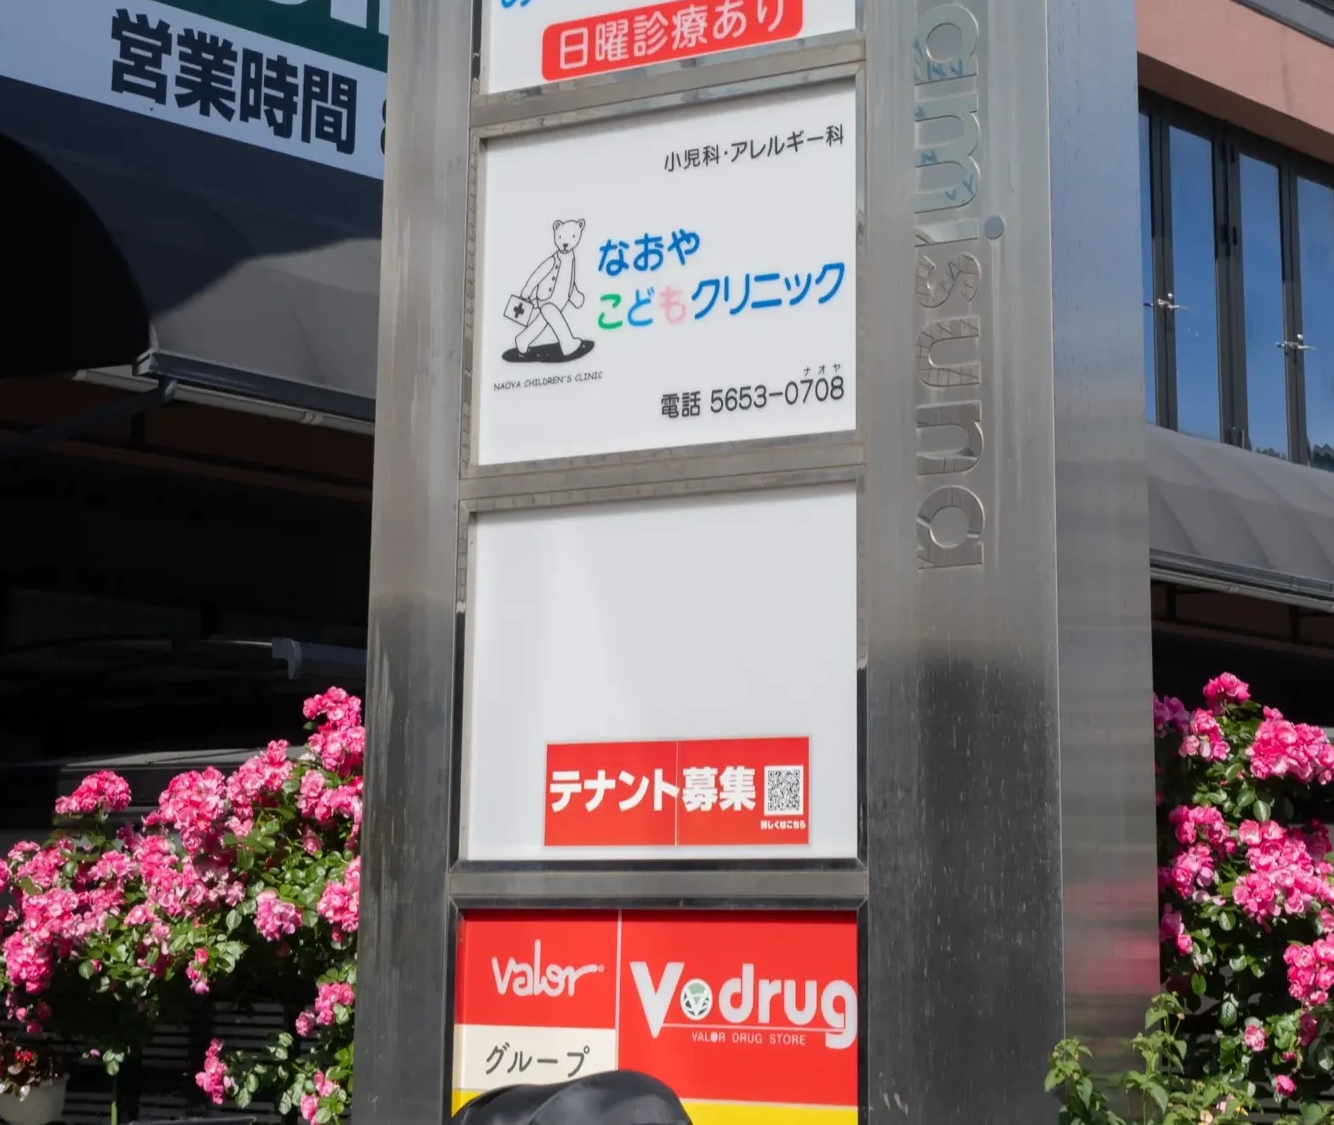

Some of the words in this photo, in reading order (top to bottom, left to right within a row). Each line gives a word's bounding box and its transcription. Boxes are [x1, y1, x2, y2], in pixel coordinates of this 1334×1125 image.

[110, 7, 358, 156] 営業時間
[664, 124, 845, 173] 小児科・アレルギー科
[597, 228, 701, 276] なおや
[597, 263, 846, 331] こどもクリニック
[493, 380, 521, 392] NAOYA
[524, 375, 572, 389] CHILDREN'S
[575, 371, 604, 383] CLINIC
[660, 392, 702, 419] 電話
[710, 375, 845, 414] 5653-0708
[549, 765, 757, 813] テナント募集
[485, 1042, 590, 1078] グループ
[691, 1031, 727, 1043] VALOR
[732, 1032, 763, 1045] DRUG
[769, 1033, 806, 1046] STORE
